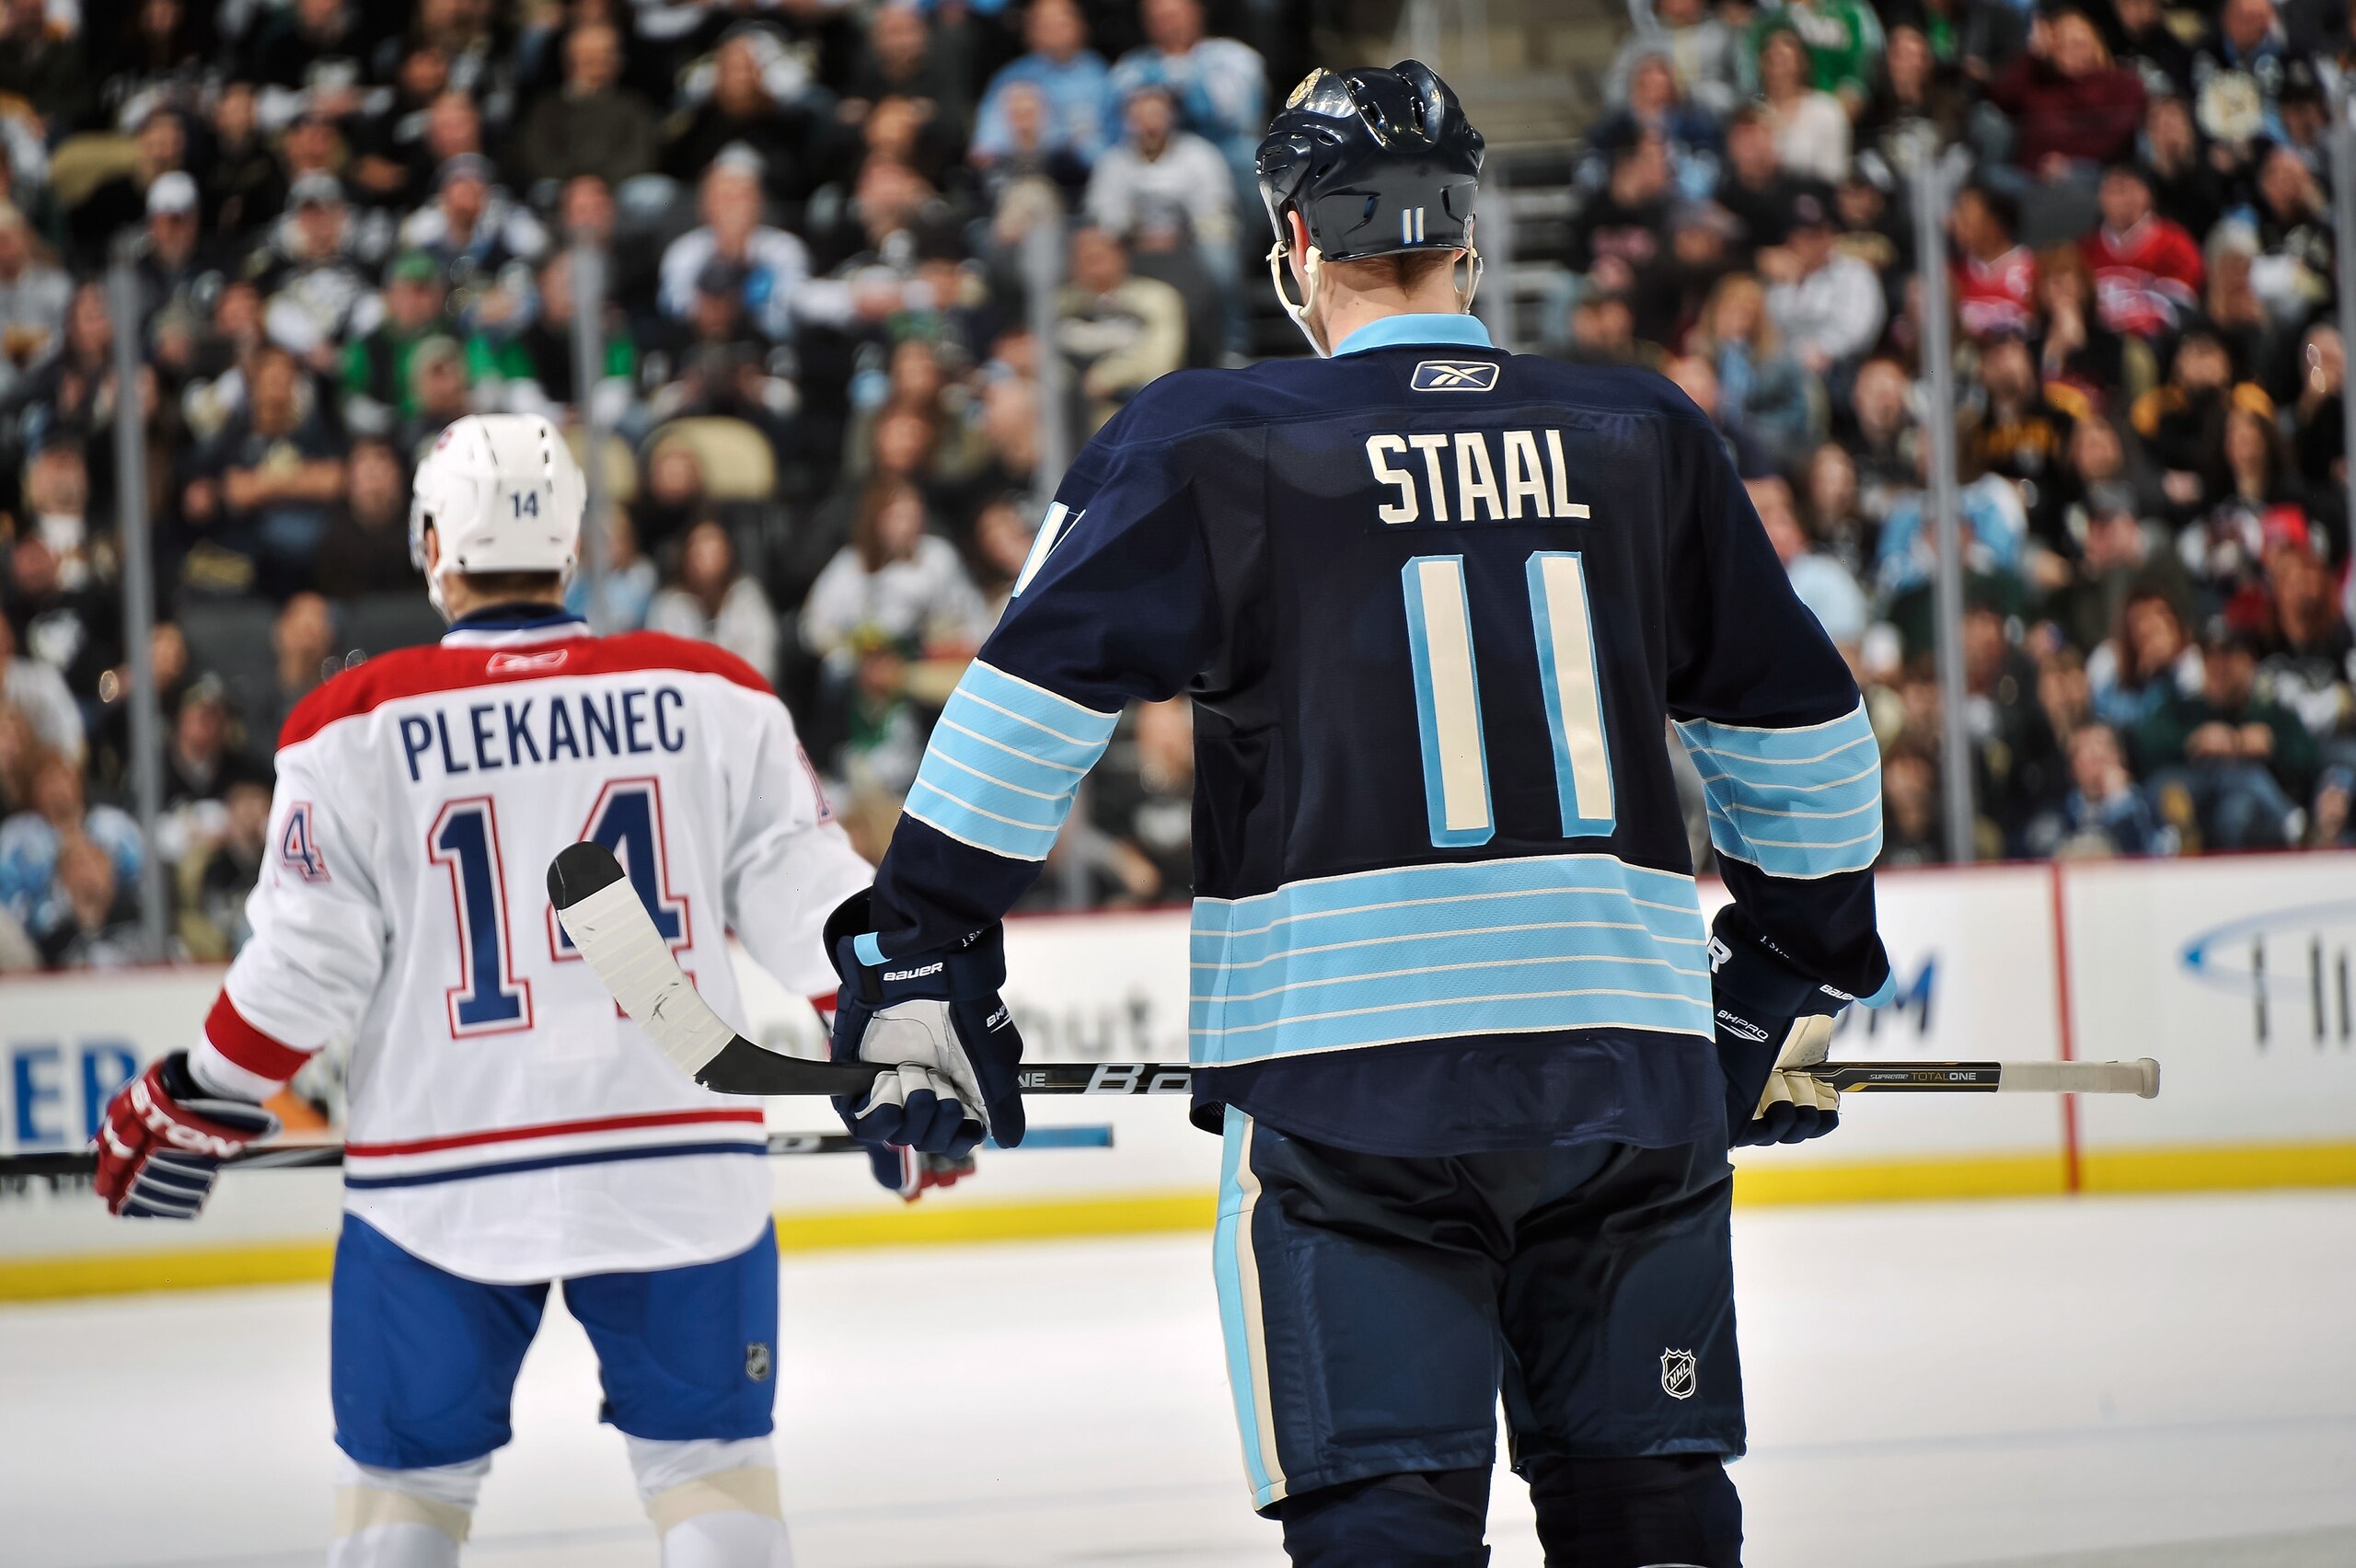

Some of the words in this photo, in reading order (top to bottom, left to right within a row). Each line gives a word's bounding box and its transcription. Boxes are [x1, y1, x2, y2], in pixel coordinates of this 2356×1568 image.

[1402, 206, 1426, 245] 11
[509, 490, 539, 518] 14
[1366, 430, 1590, 524] STAAL
[1401, 550, 1617, 848] 11
[398, 686, 685, 781] PLEKANEC
[1669, 1362, 1690, 1389] NHL
